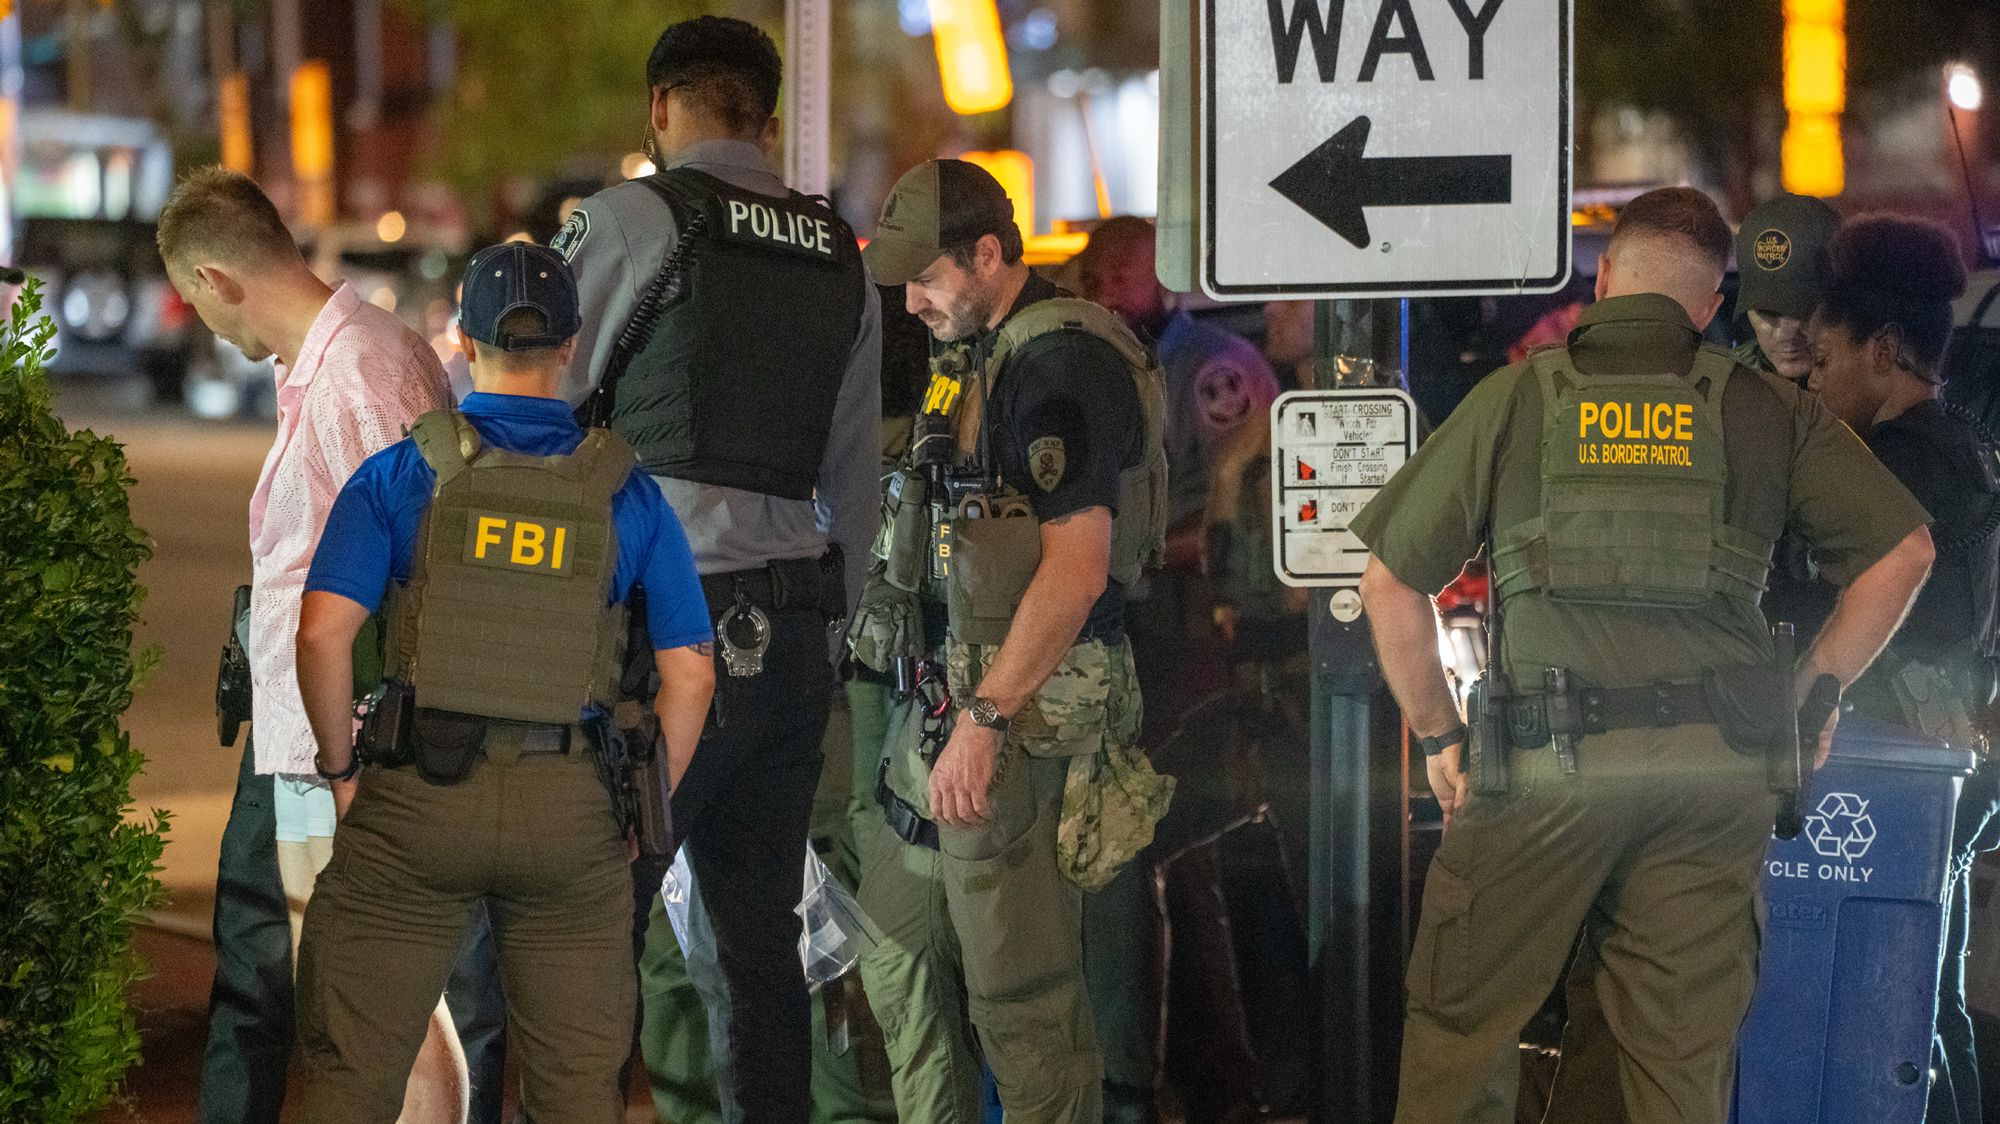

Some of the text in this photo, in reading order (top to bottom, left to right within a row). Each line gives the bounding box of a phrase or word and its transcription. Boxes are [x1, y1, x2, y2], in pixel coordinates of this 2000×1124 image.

[1266, 0, 1503, 84] WAY
[728, 200, 832, 255] POLICE
[1757, 252, 1785, 260] PATROL
[1758, 244, 1786, 252] BORDER
[1353, 404, 1392, 415] CROSSING
[1580, 401, 1693, 440] POLICE
[1333, 447, 1385, 459] DON'T START
[1579, 443, 1692, 466] U.S. BORDER PATROL
[1331, 462, 1387, 474] Finish Crossing
[1360, 474, 1385, 484] Started
[1331, 503, 1355, 513] DON'T
[475, 517, 566, 569] FBI
[939, 525, 951, 576] FBI
[1764, 861, 1874, 883] CLE ONLY
